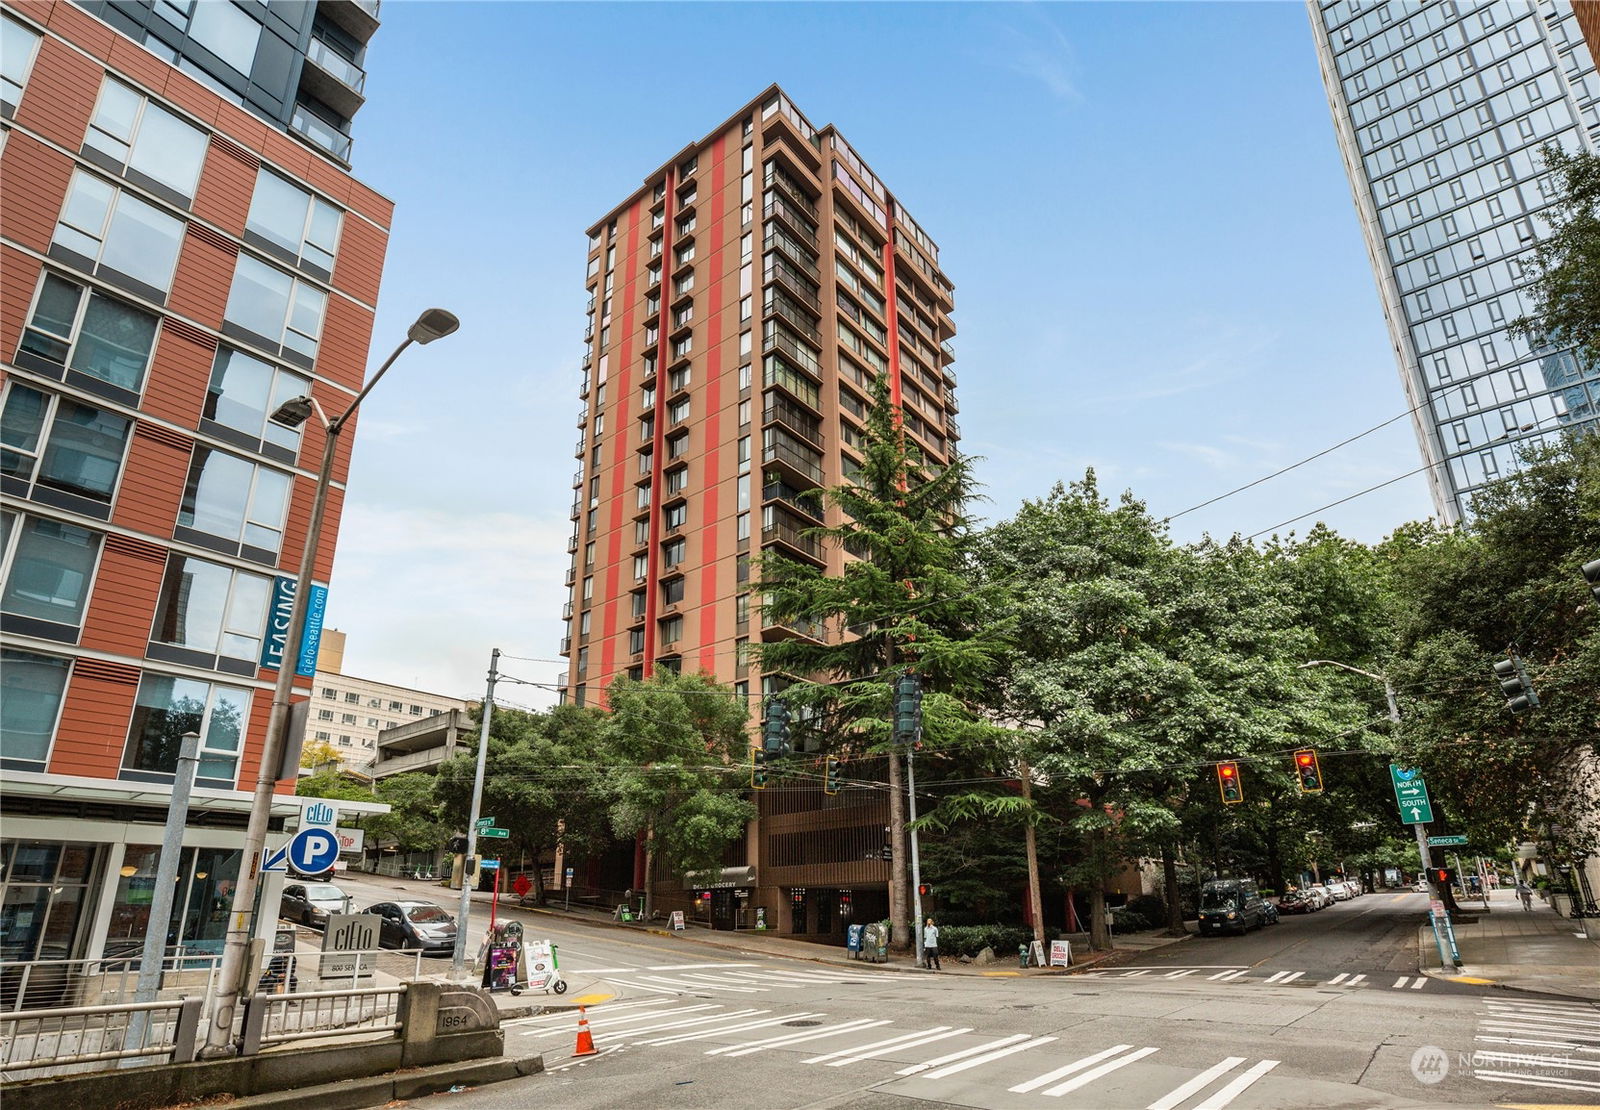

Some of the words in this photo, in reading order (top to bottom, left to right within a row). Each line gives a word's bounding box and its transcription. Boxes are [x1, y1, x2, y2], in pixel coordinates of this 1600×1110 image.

[267, 580, 298, 667] LEASING
[303, 589, 325, 674] cielo-seattle.com
[1397, 780, 1422, 788] NORTH
[1402, 799, 1426, 807] SOUTH
[303, 836, 330, 865] P
[344, 963, 368, 971] SENCA
[442, 1015, 467, 1027] 1964
